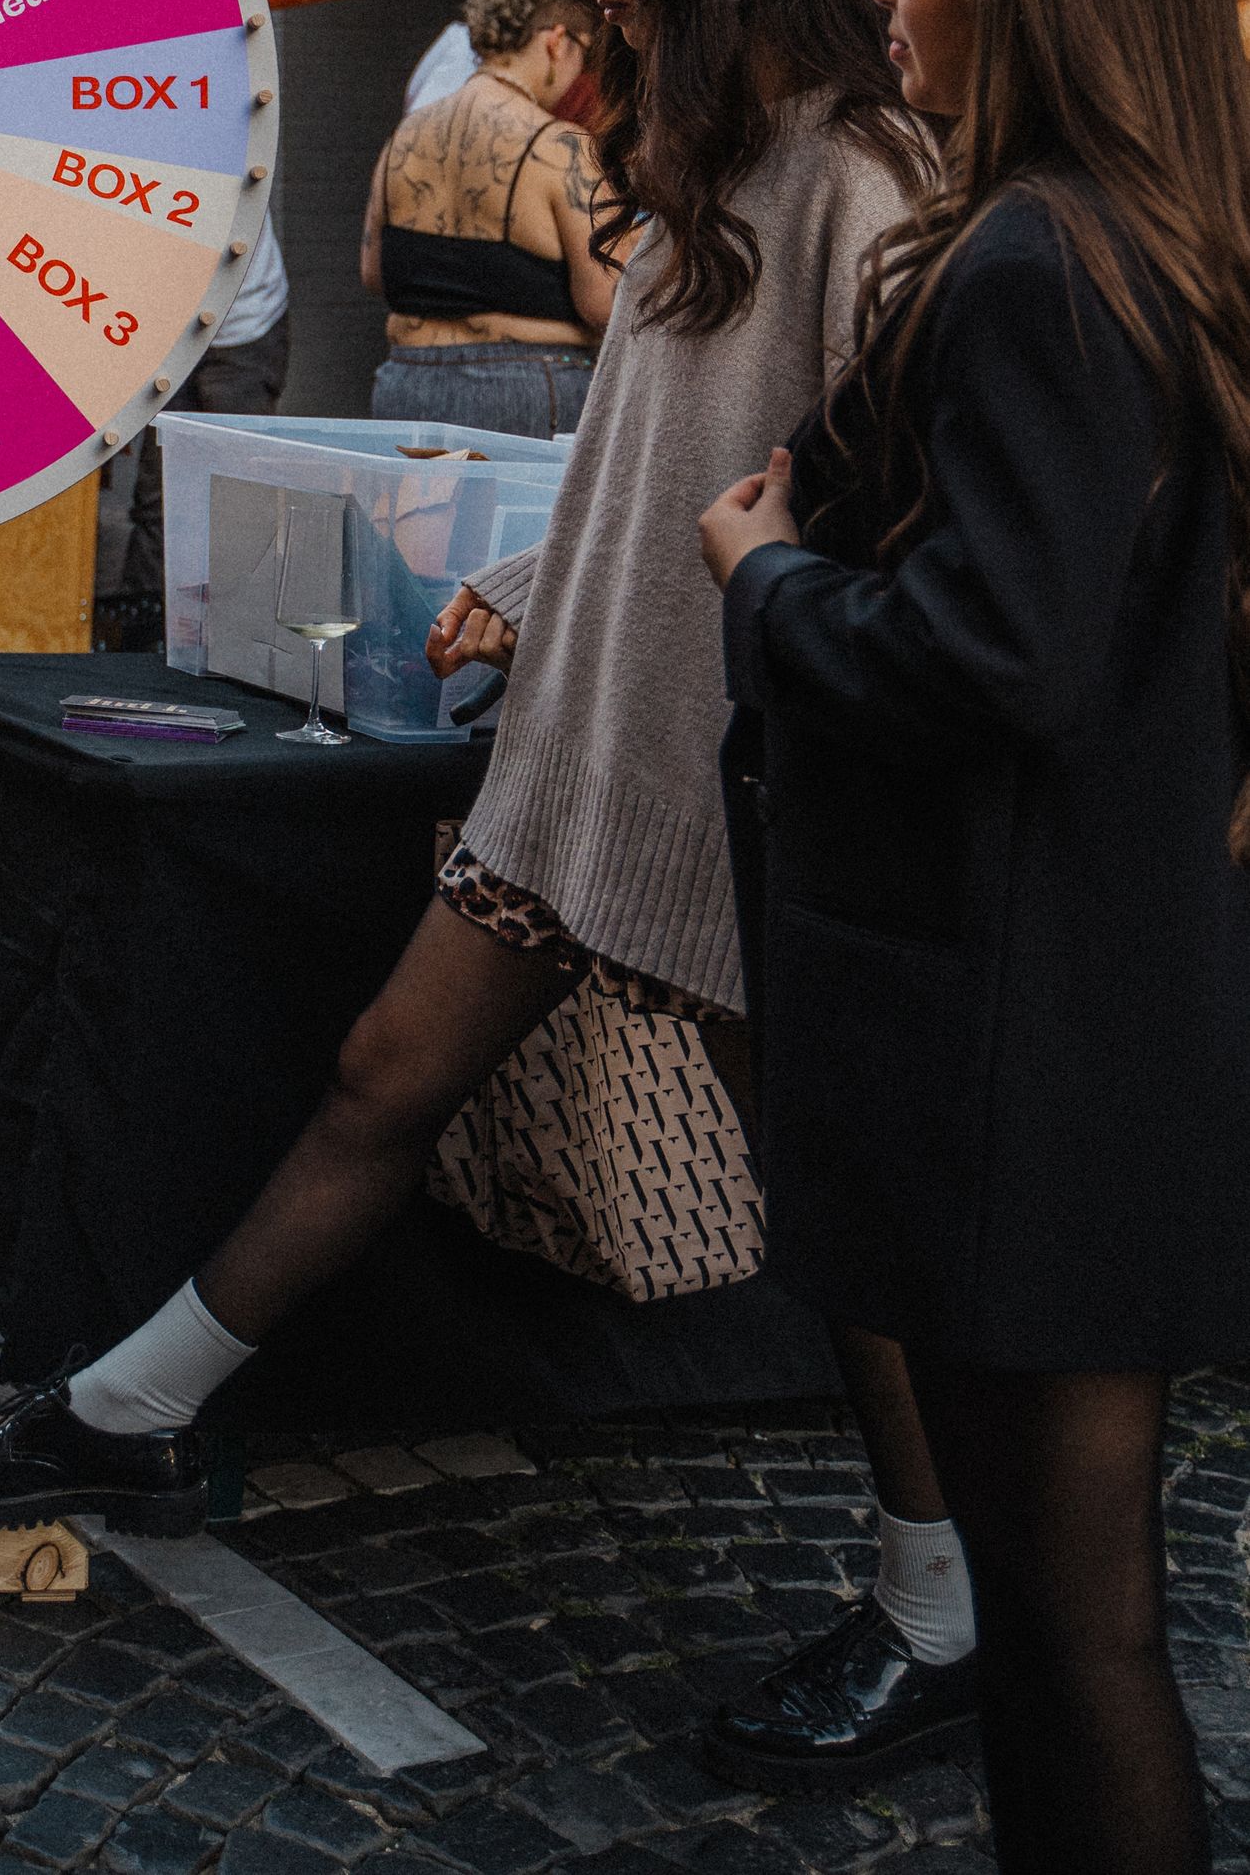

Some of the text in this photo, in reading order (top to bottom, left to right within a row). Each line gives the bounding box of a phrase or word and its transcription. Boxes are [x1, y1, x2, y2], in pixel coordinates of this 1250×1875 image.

[73, 76, 209, 109] BOX 1
[52, 150, 199, 227] BOX 2
[7, 234, 139, 346] BOX 3
